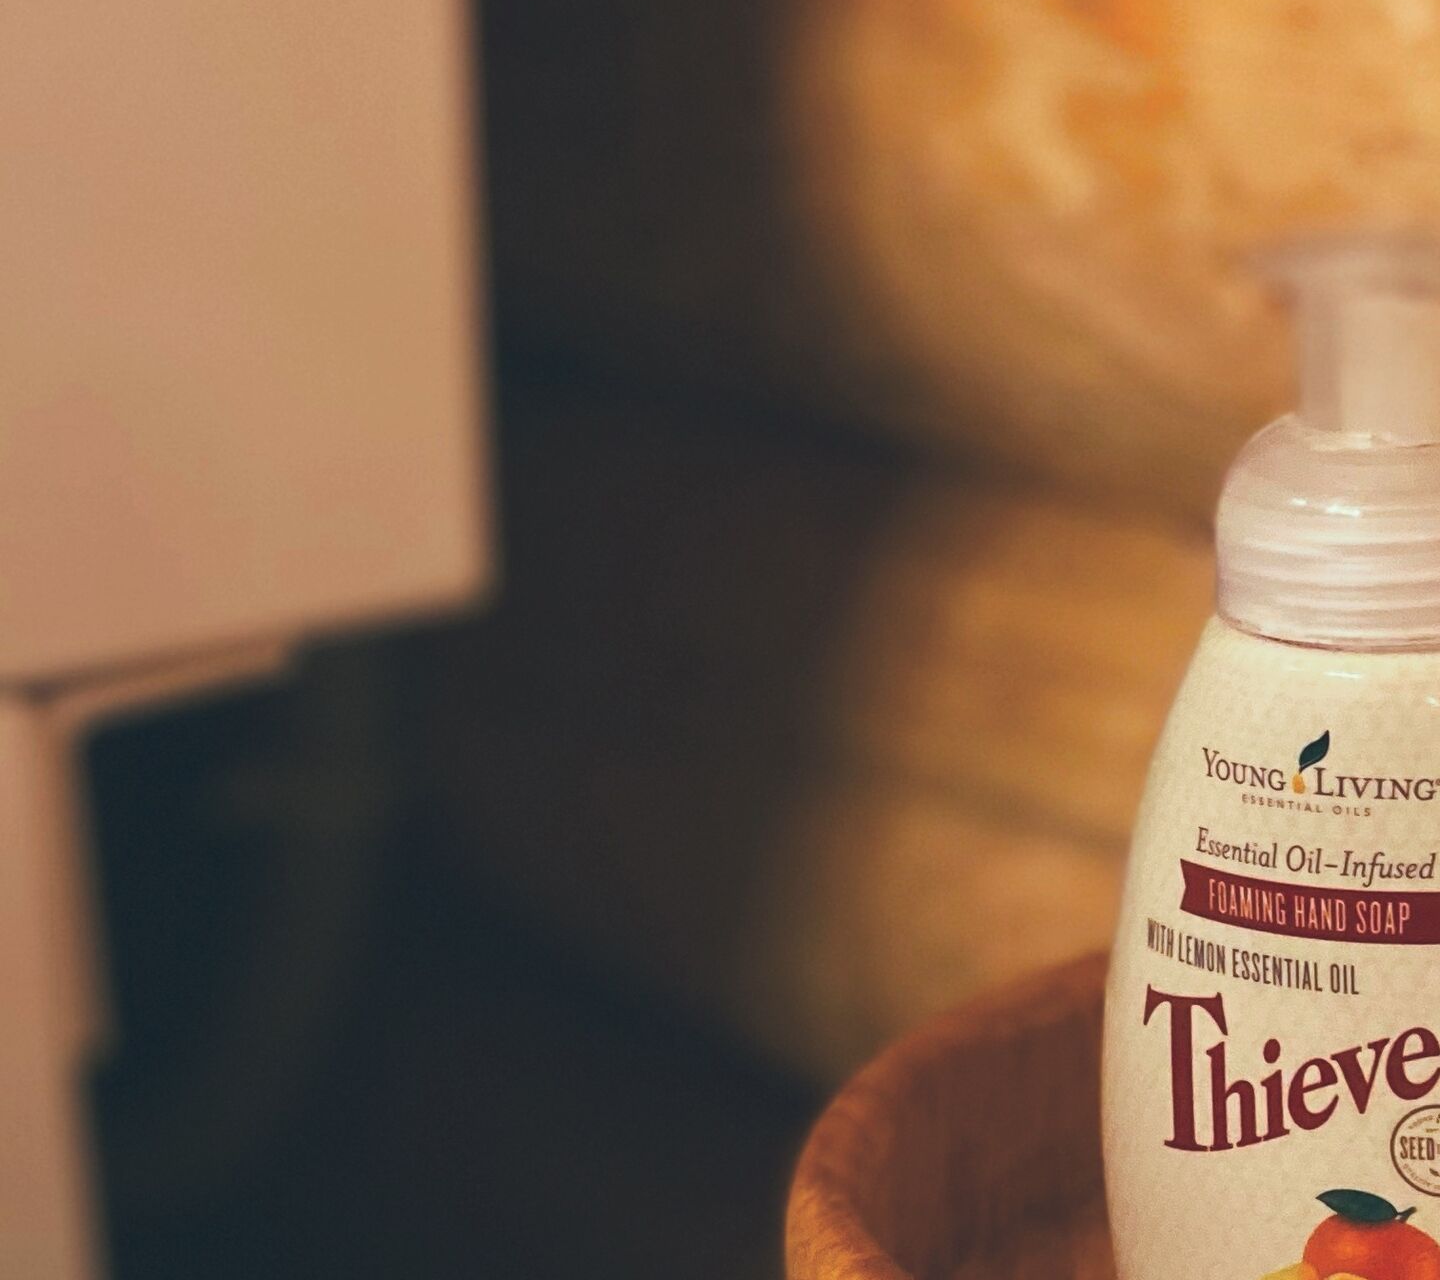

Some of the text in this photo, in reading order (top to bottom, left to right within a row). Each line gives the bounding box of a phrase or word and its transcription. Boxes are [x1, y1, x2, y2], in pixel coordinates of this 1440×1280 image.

[1202, 746, 1287, 792] YOUNG
[1241, 793, 1372, 818] ESSENTIAL OILS
[1195, 825, 1437, 888] Essential Oil-Infused
[1208, 878, 1411, 936] FOAMING HAND SOAP
[1147, 917, 1360, 996] WITH LEMON ESSENTIAL OIL
[1399, 1135, 1436, 1161] SEED
